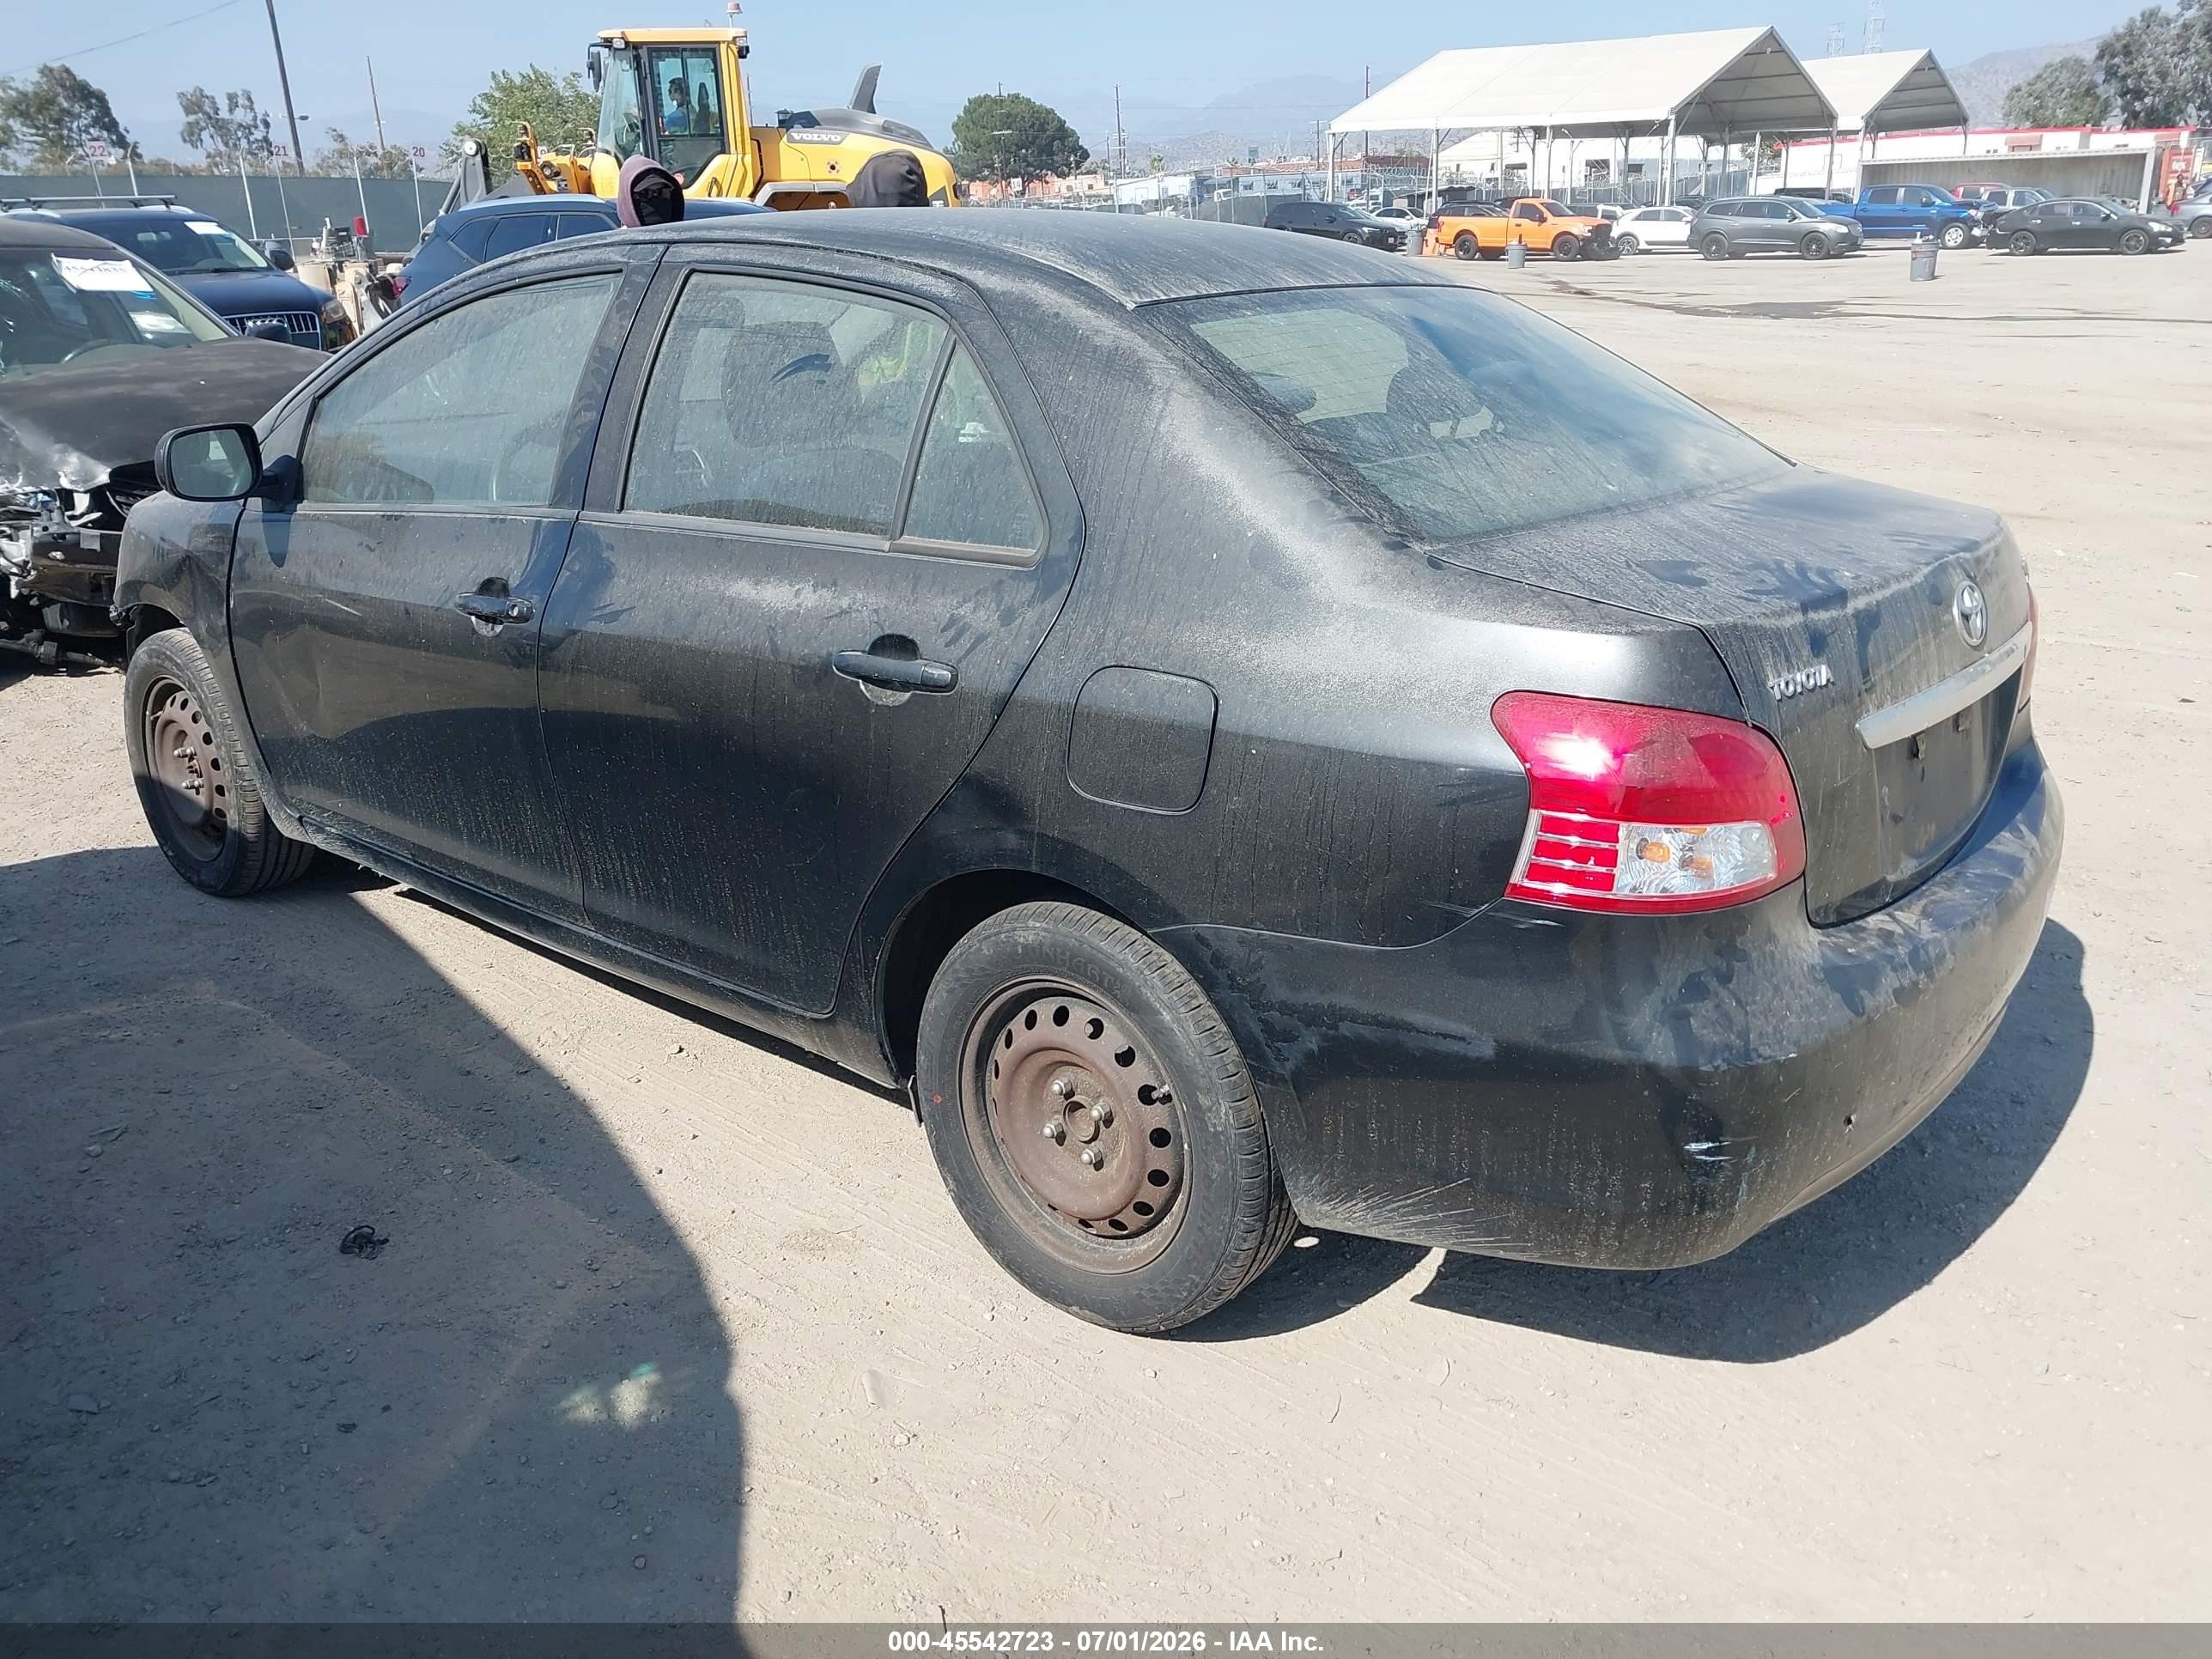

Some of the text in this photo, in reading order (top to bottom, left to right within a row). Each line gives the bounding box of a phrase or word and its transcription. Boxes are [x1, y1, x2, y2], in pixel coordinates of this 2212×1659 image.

[791, 132, 842, 143] VOLVO
[89, 145, 106, 156] 22
[274, 144, 289, 156] 21
[412, 146, 425, 157] 20
[1766, 665, 1835, 702] TOYOTA
